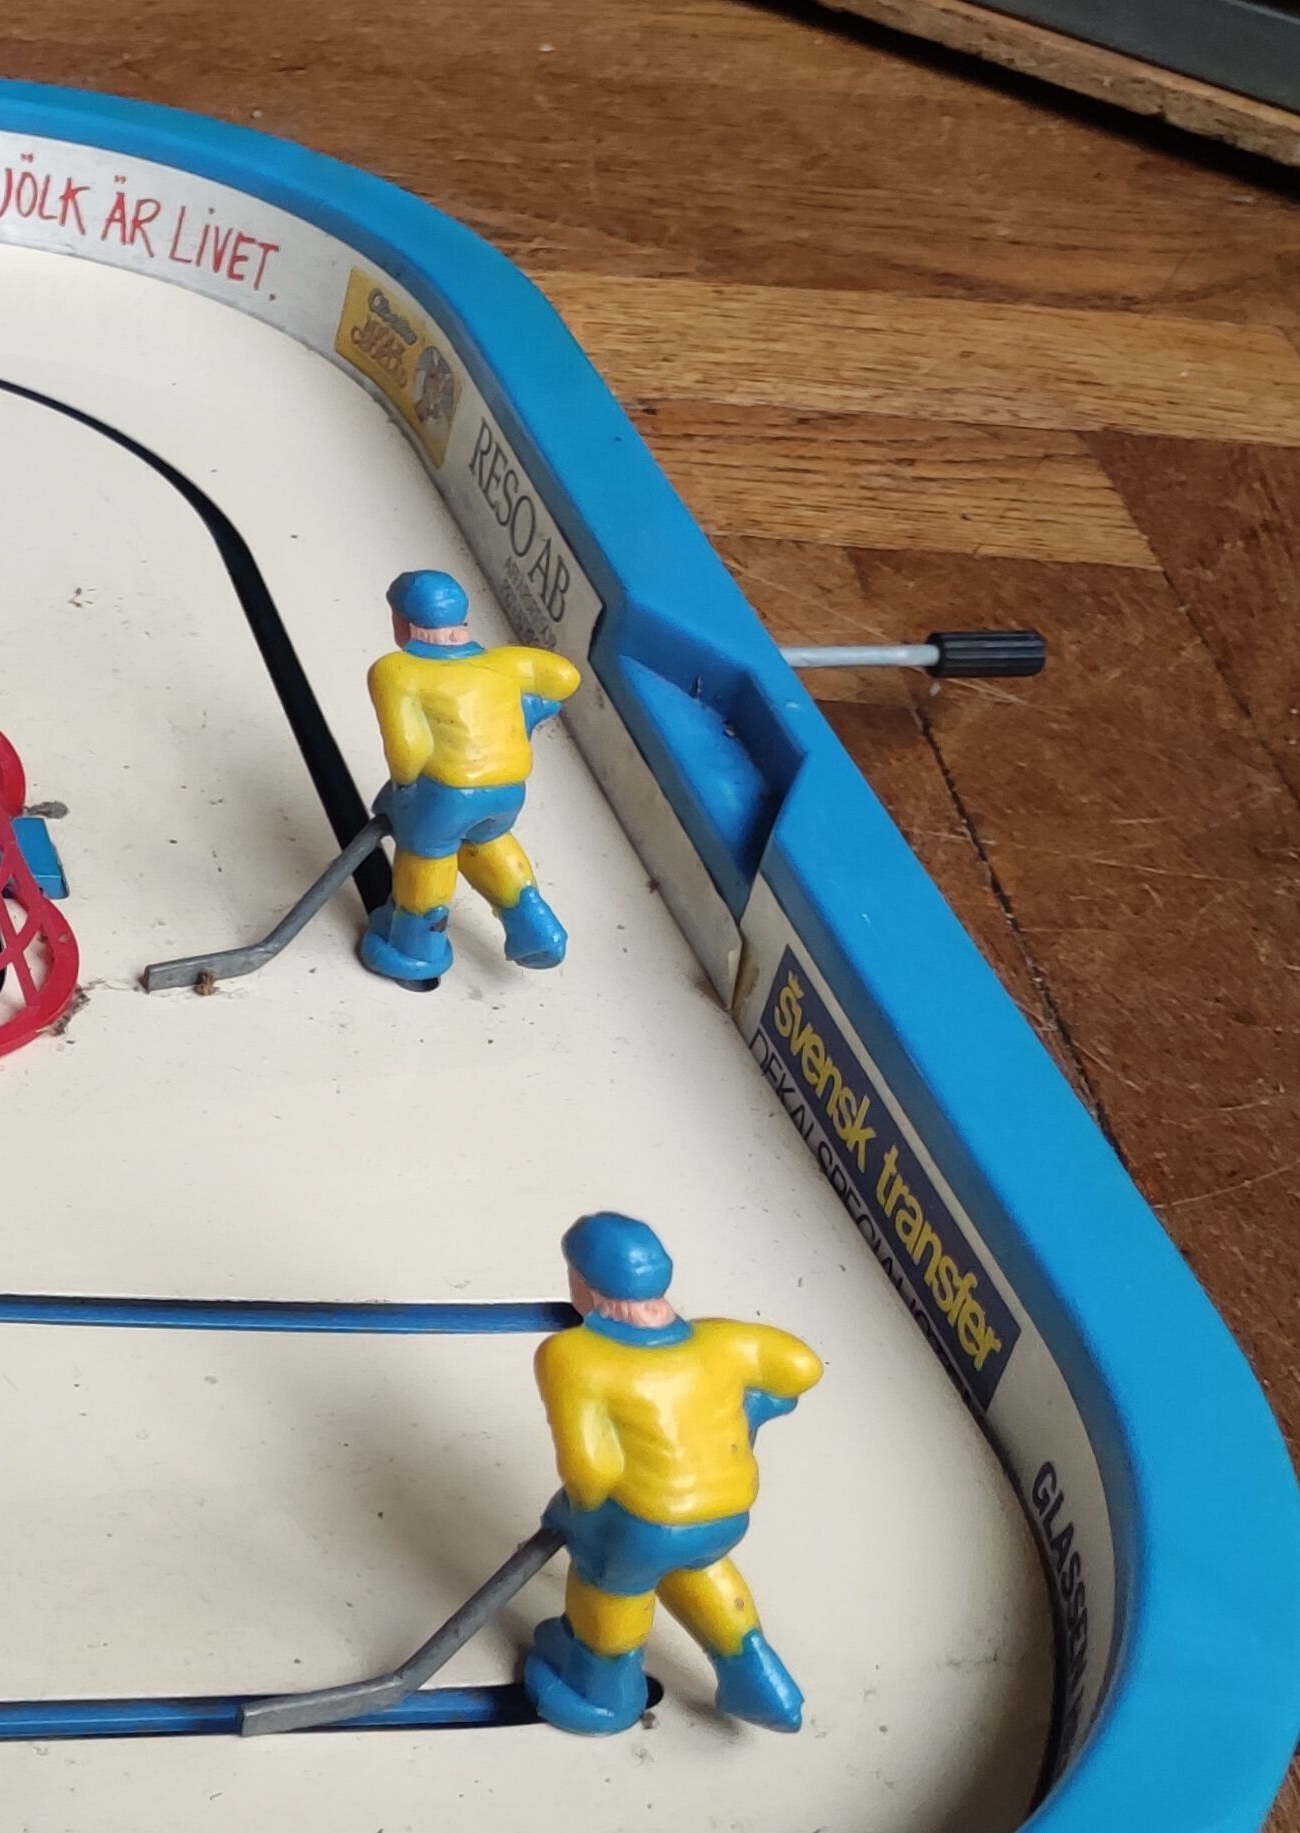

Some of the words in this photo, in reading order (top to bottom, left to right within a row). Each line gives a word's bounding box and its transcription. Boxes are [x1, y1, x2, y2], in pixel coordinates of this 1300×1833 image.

[101, 174, 161, 258] ÄR
[468, 416, 536, 558] RESO
[527, 537, 570, 623] AB
[773, 974, 876, 1173] svensk
[875, 1144, 1002, 1373] transfer
